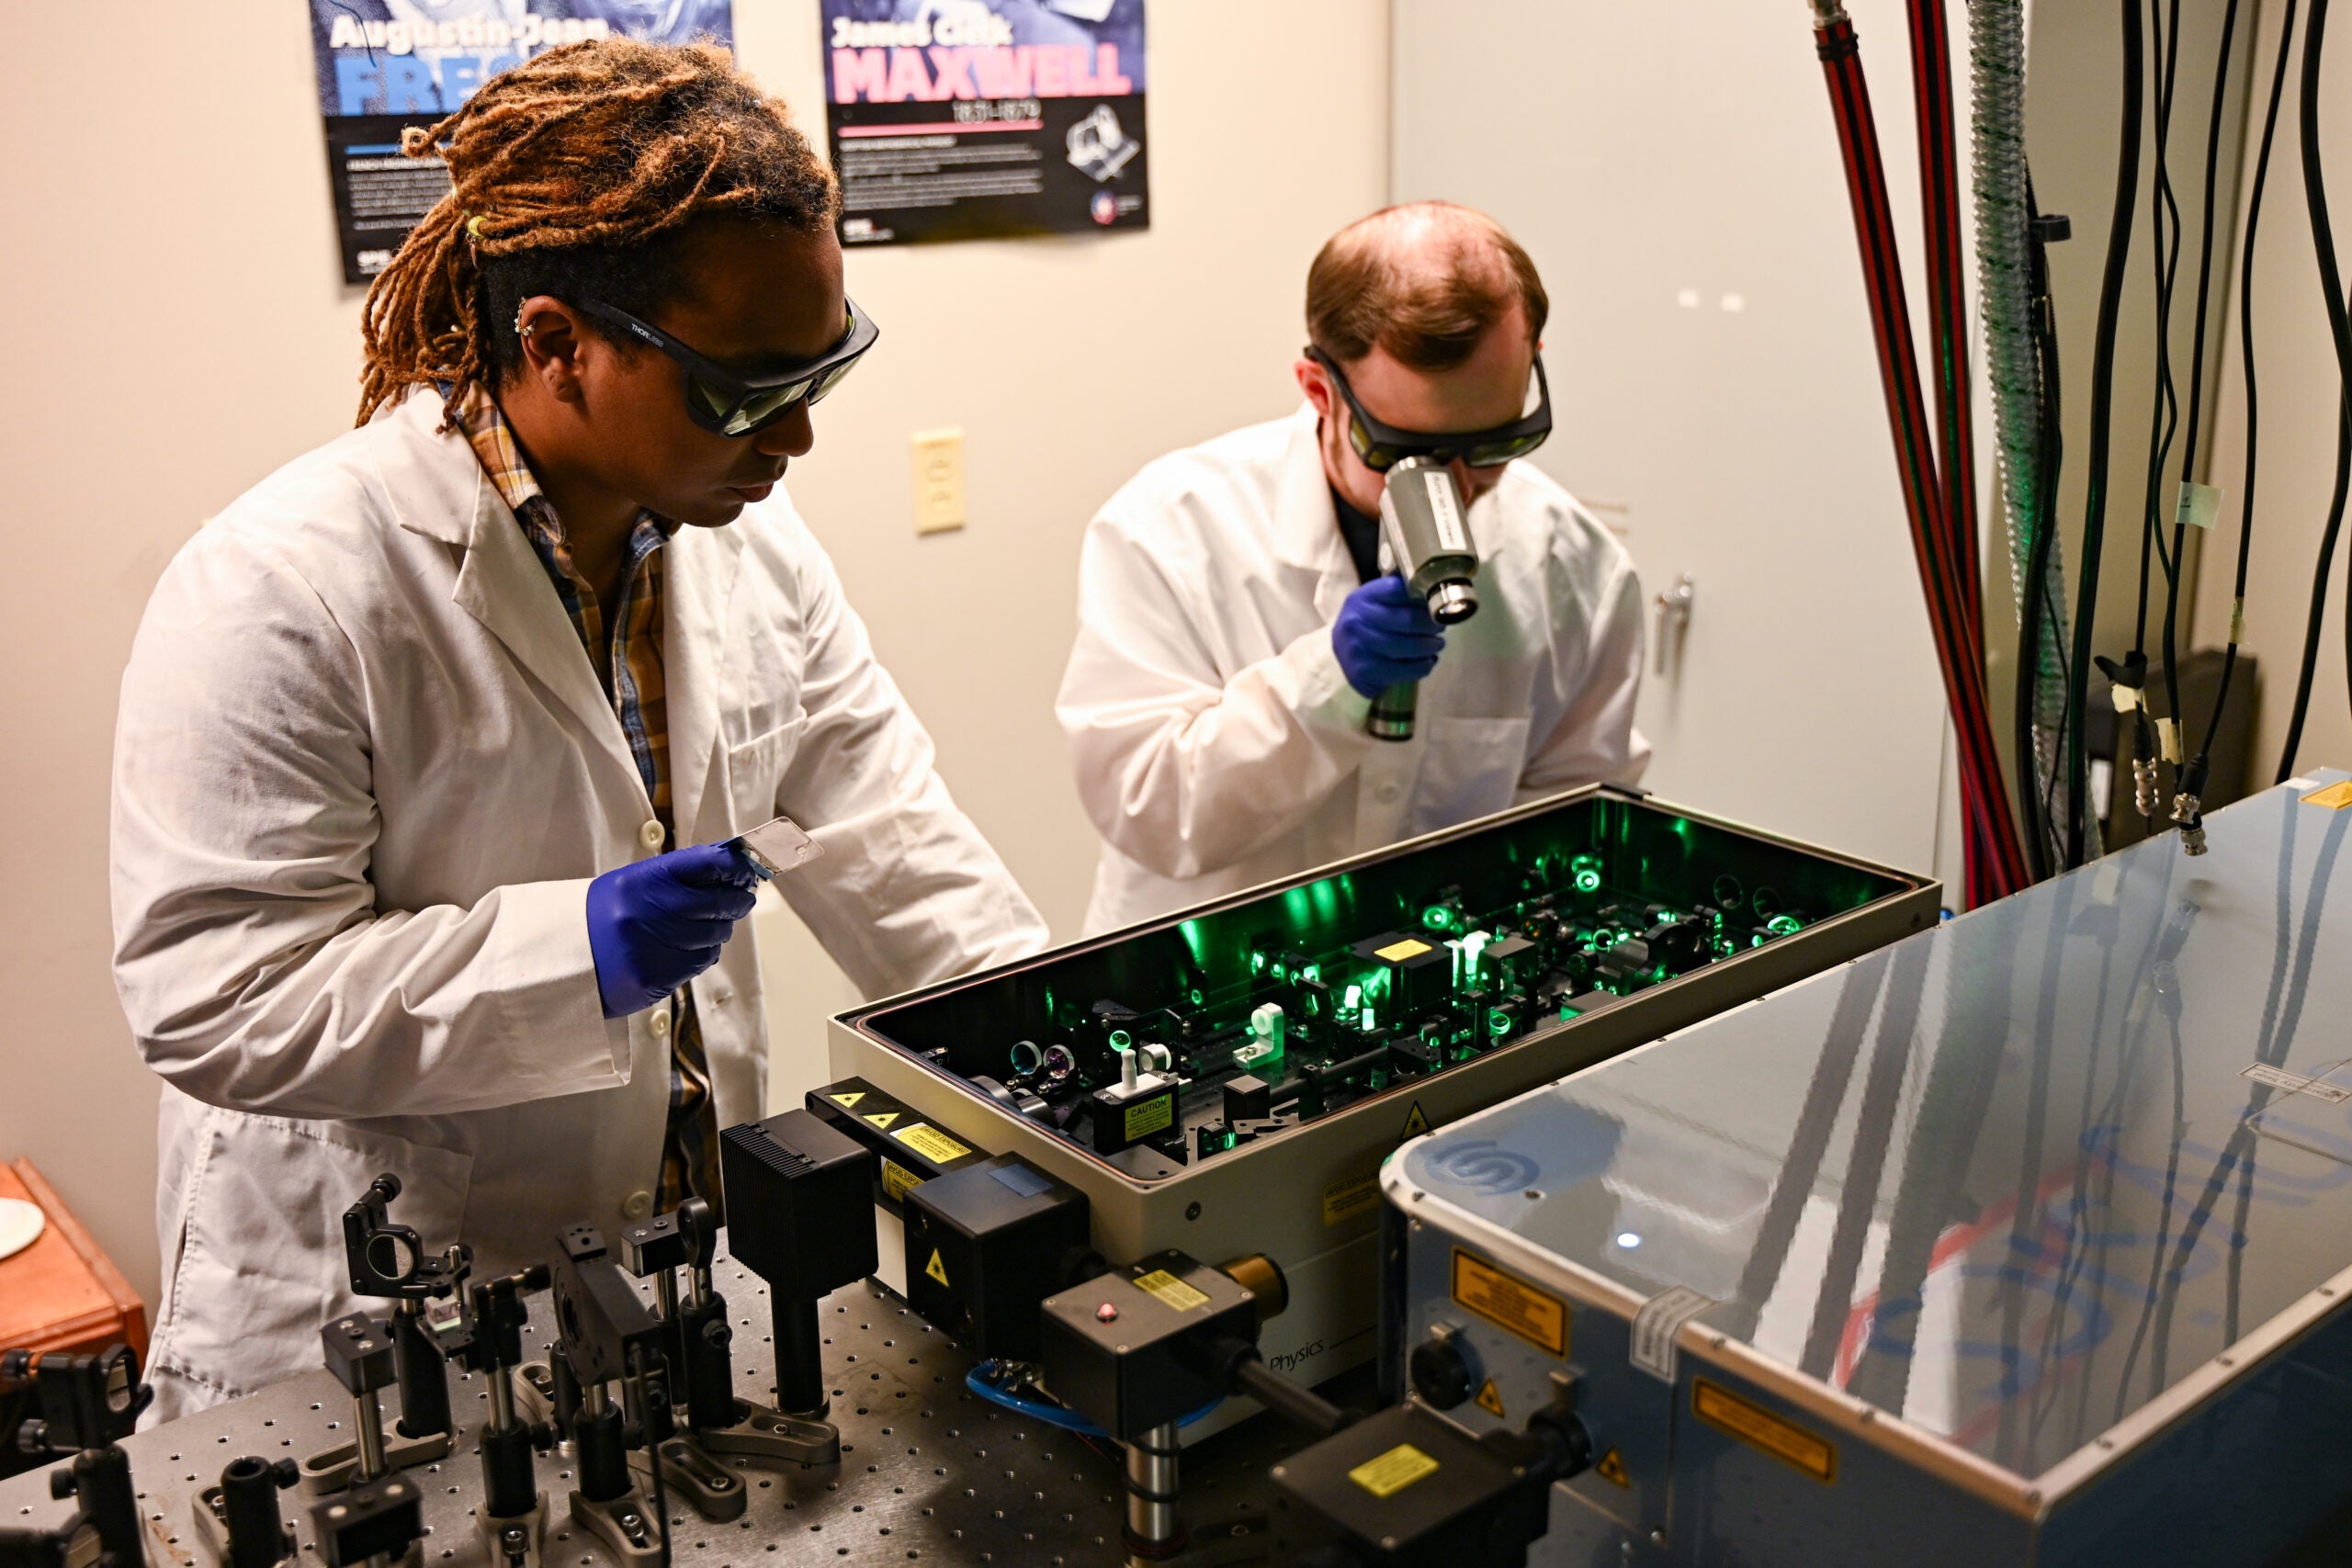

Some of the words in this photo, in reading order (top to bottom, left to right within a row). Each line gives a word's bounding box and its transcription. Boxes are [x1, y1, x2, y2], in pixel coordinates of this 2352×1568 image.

[831, 17, 932, 48] James
[832, 42, 1132, 104] MAXWELL
[2278, 1080, 2332, 1100] Warrnty
[1131, 1099, 1166, 1117] CAUTION
[922, 1126, 940, 1140] AVOID
[1270, 1338, 1323, 1371] Physics
